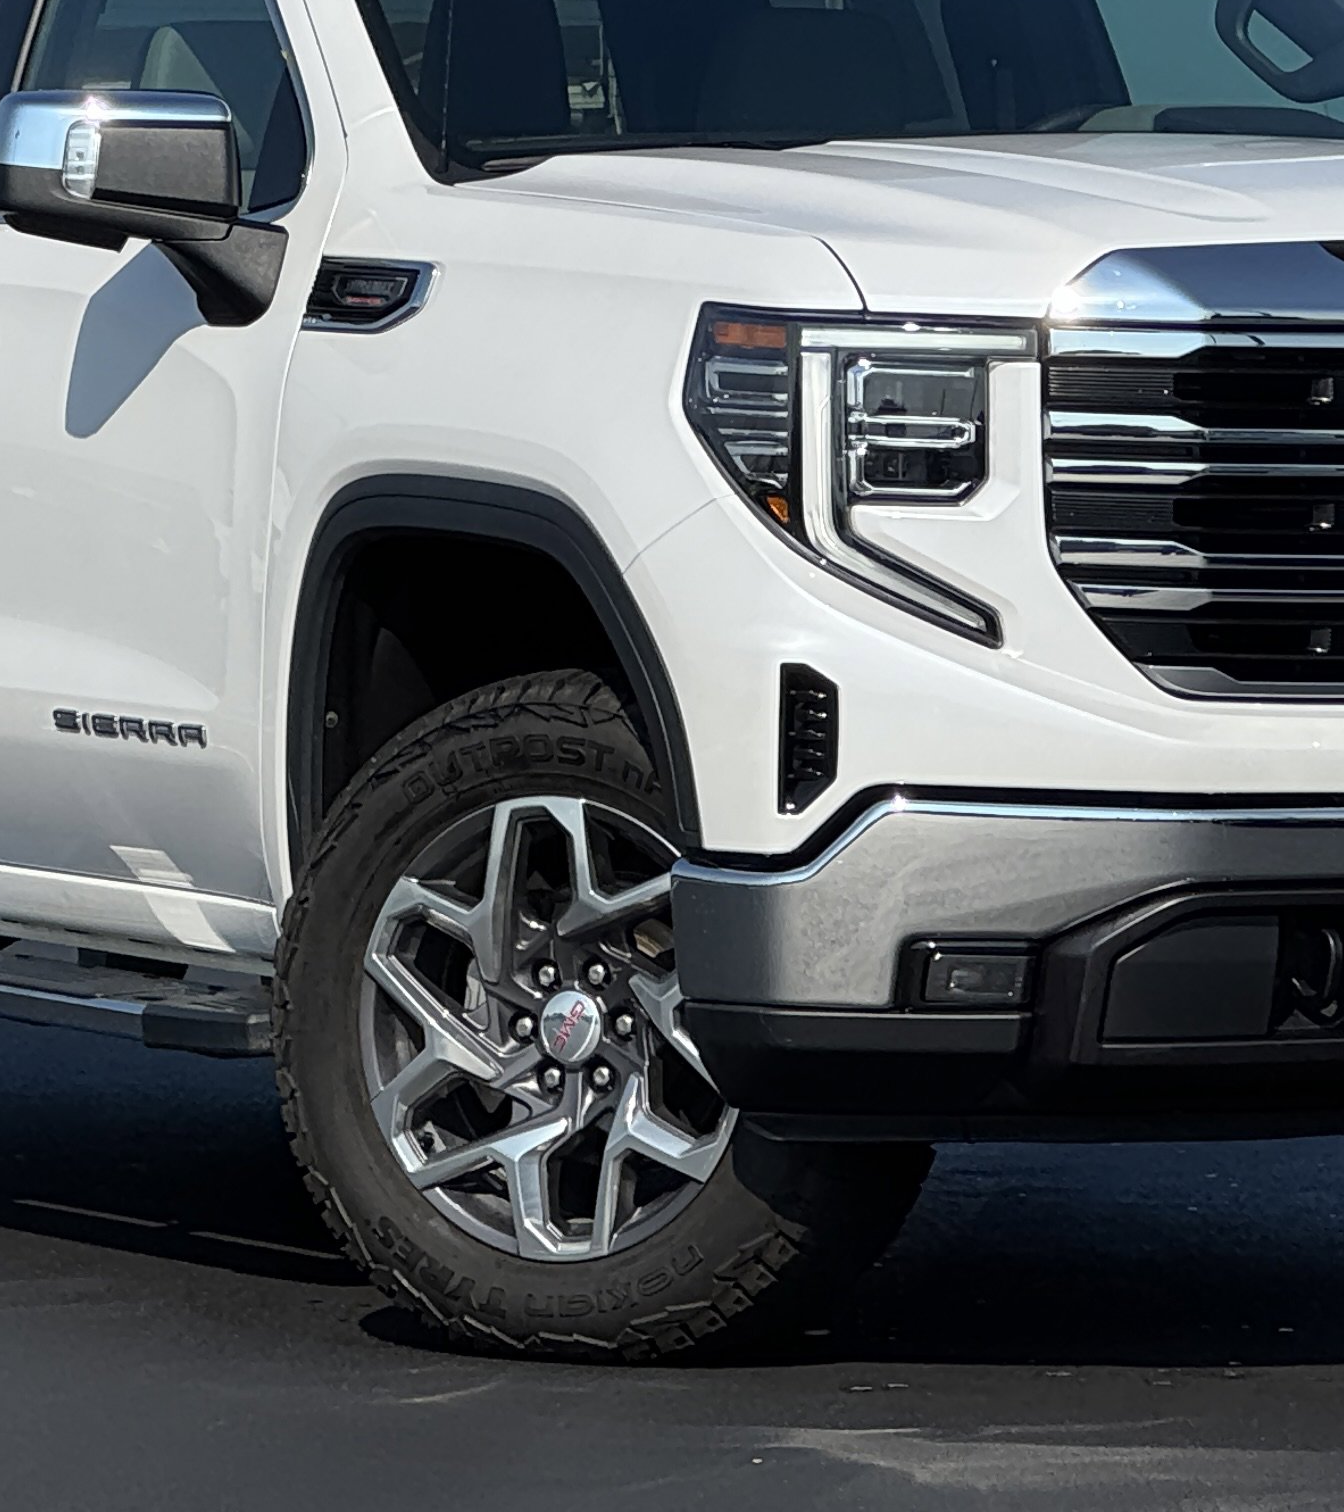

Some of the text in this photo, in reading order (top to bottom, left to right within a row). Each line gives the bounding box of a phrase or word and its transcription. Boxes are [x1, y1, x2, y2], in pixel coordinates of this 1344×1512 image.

[52, 707, 208, 749] SIERRA
[401, 733, 615, 805] OUTPOST
[553, 999, 586, 1054] GMC
[374, 1214, 507, 1320] TYRES
